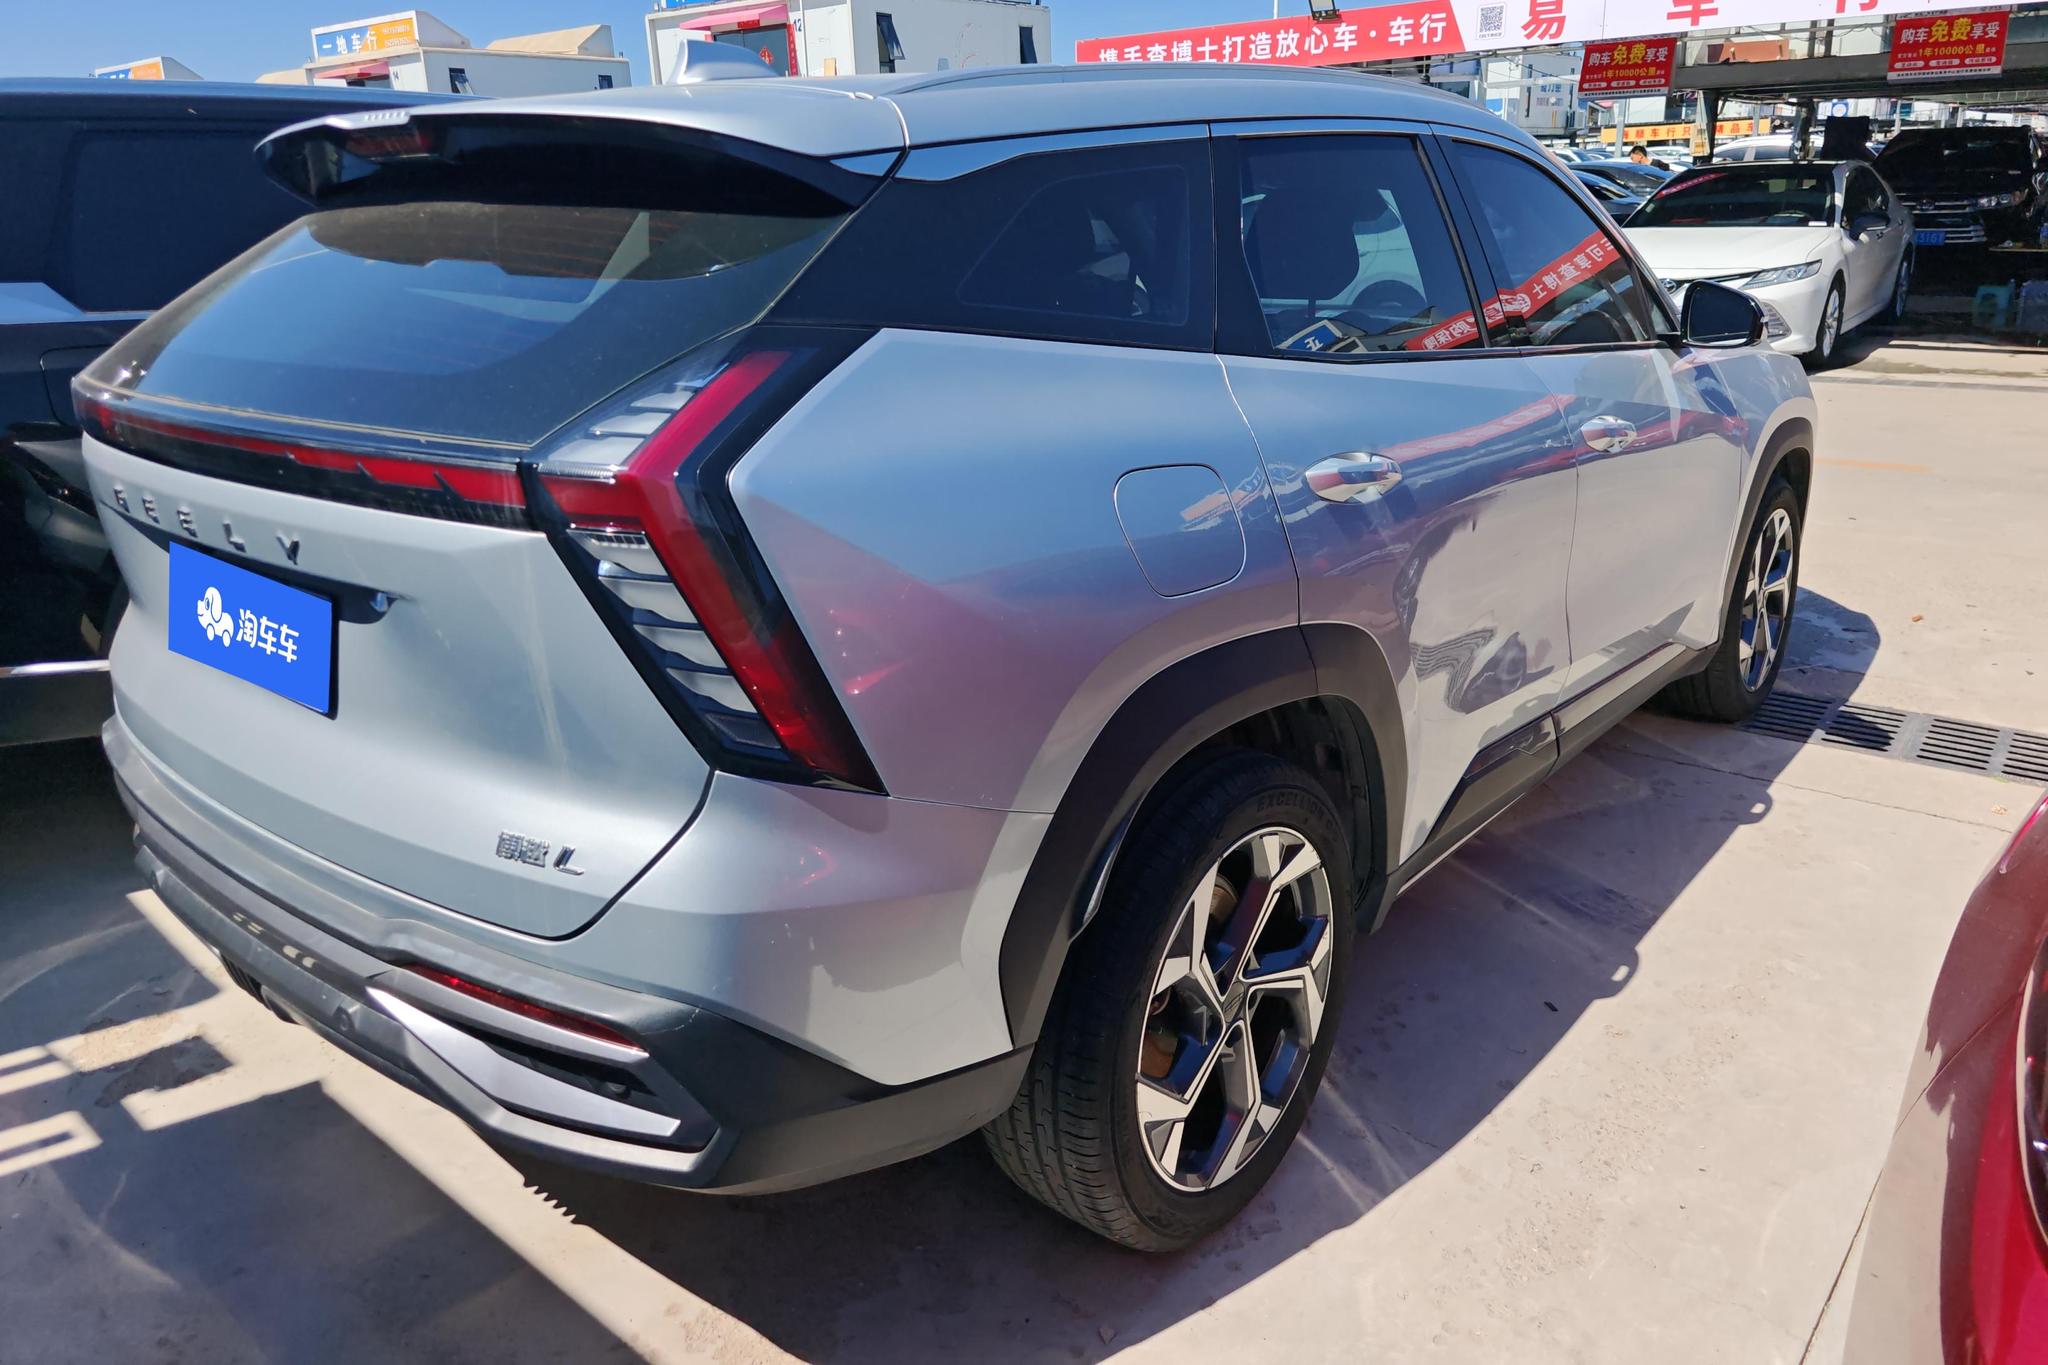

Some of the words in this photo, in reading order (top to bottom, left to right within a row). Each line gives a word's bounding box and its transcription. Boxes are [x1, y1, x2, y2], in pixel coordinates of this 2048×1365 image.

[322, 31, 377, 54] 一地车行
[1900, 17, 2000, 44] 购车免费享受
[1588, 42, 1668, 66] 购车免费享受
[113, 483, 301, 566] GEELY
